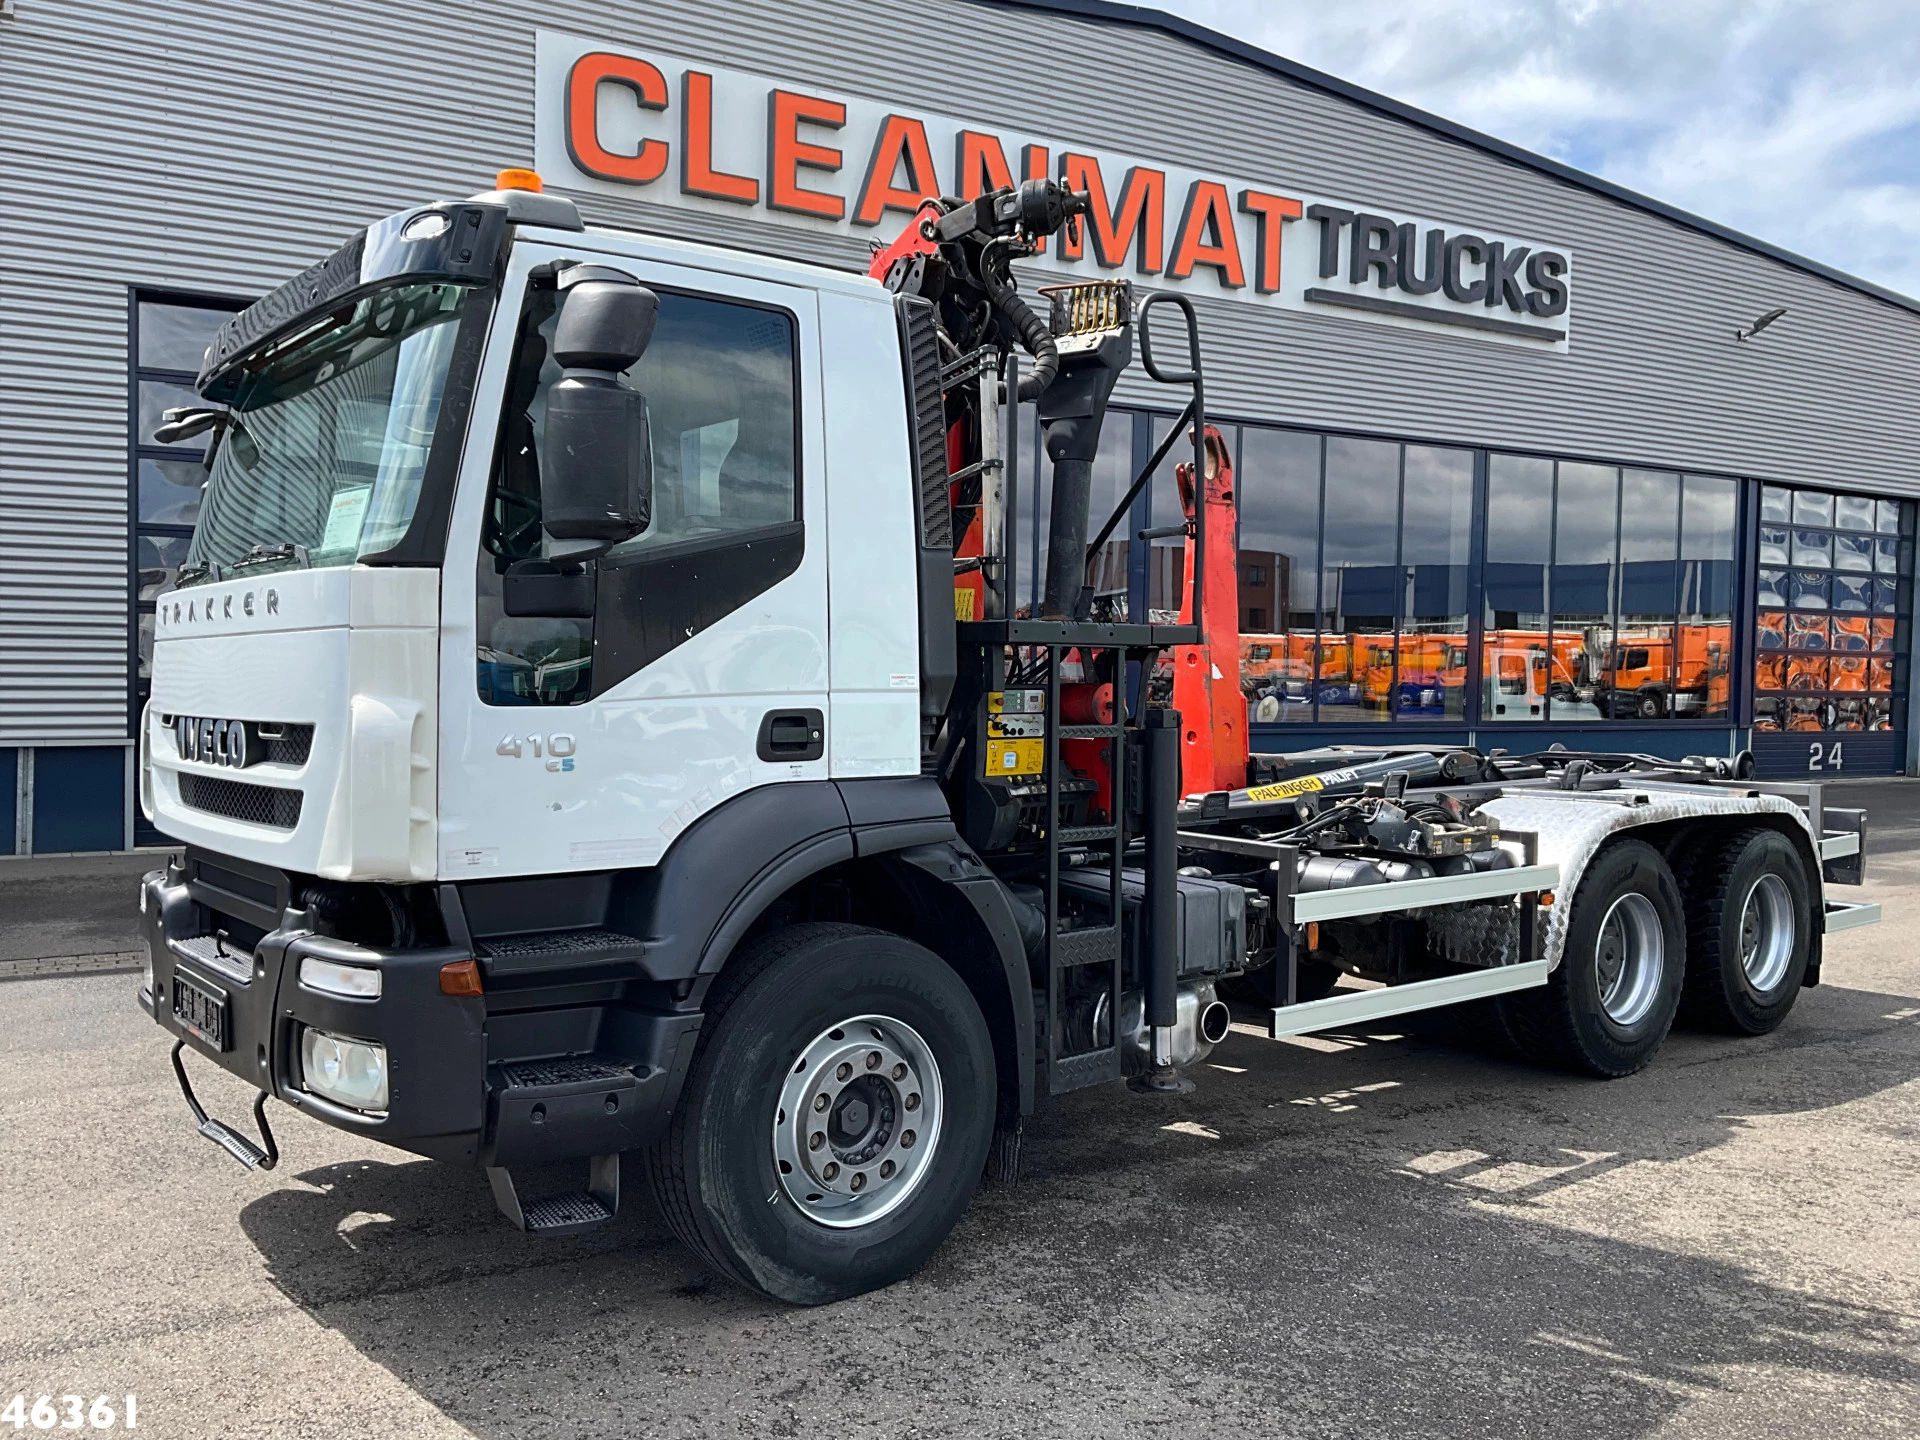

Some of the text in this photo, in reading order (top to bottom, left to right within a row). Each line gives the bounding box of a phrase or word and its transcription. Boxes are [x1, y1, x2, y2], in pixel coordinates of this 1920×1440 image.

[1306, 203, 1568, 318] TRUCKS
[162, 588, 279, 626] TRAKKER
[178, 716, 247, 769] IVECO
[496, 732, 576, 758] 410
[1809, 742, 1843, 770] 24
[1251, 769, 1360, 800] PALFINGER PALIFT
